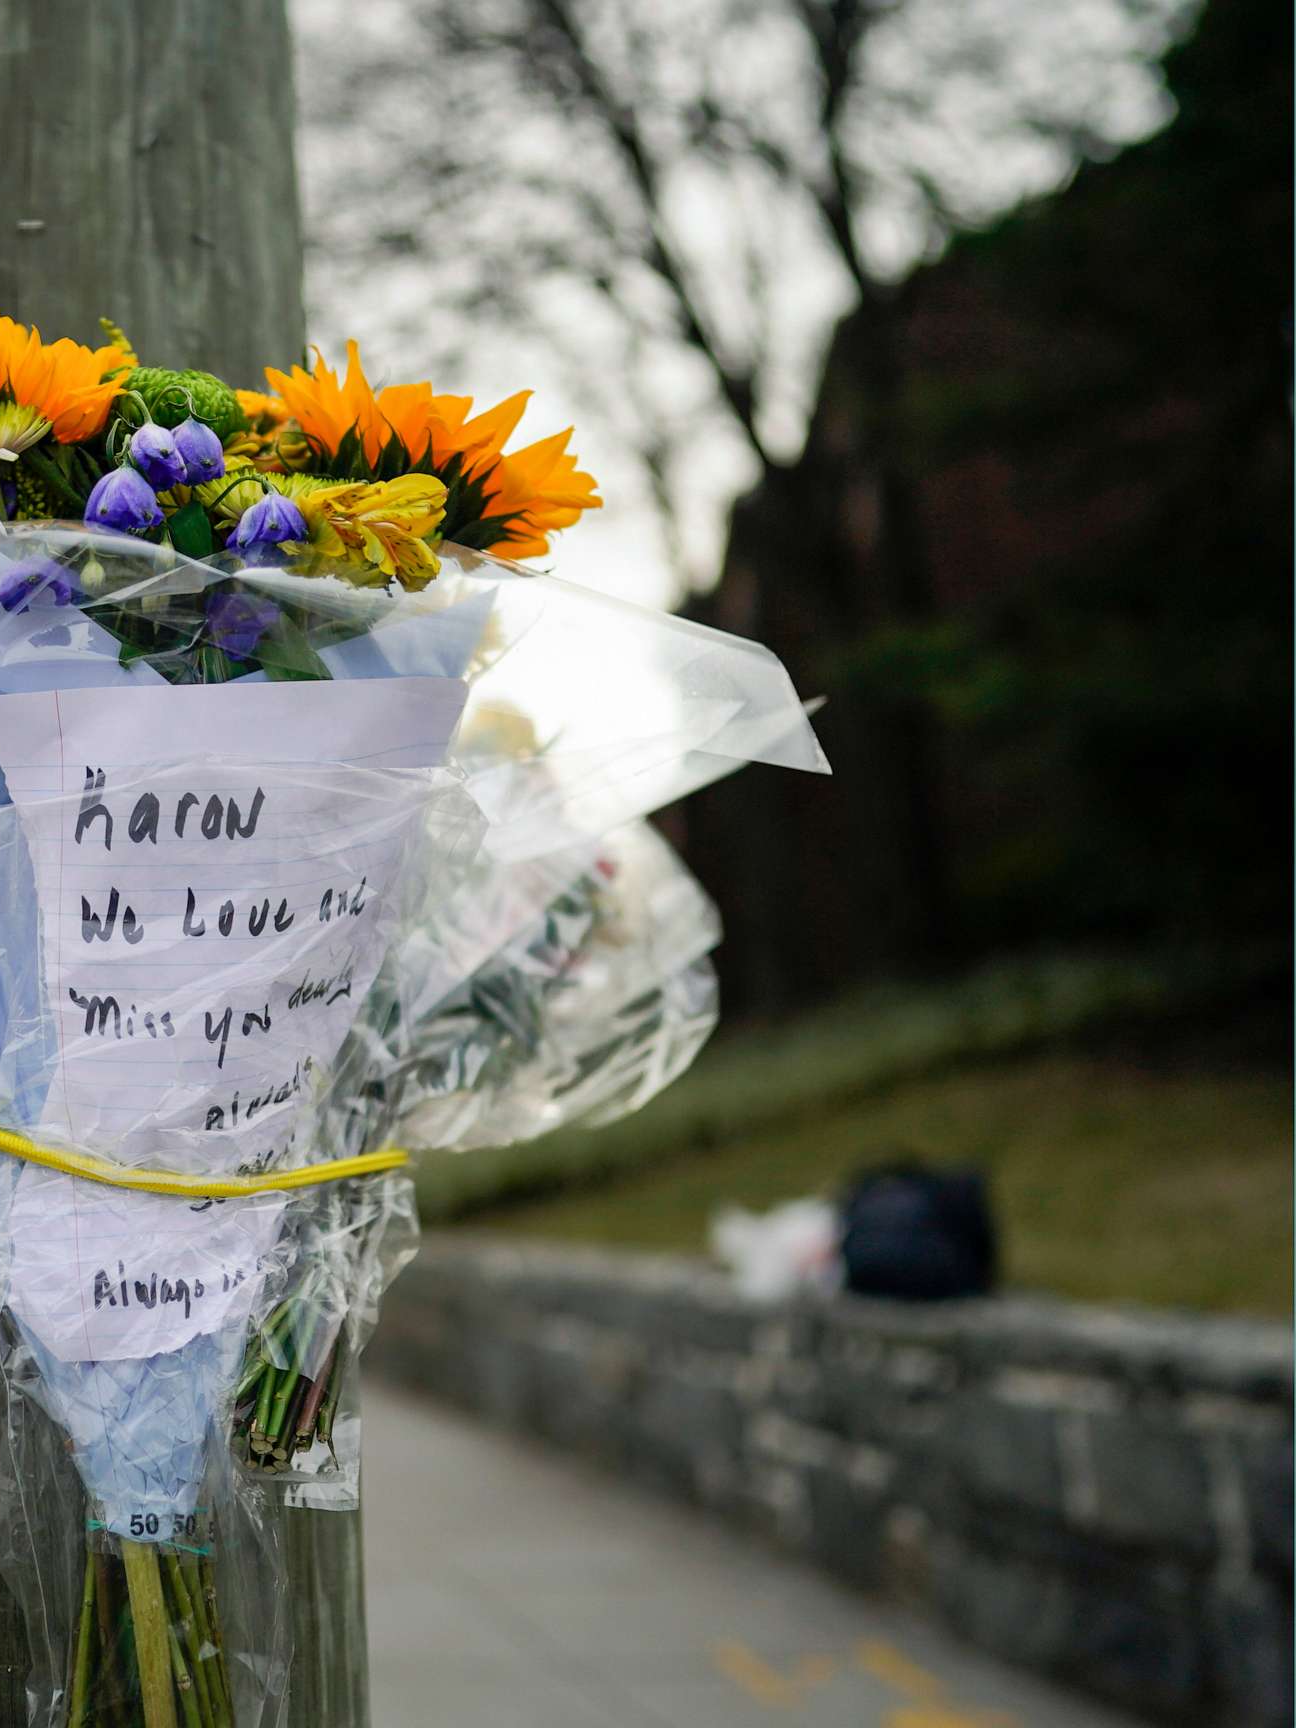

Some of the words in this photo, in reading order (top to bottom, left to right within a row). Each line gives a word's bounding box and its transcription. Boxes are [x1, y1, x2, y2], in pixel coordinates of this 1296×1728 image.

[81, 886, 144, 944] We
[182, 887, 294, 937] Love
[319, 876, 366, 922] and
[69, 987, 175, 1039] Miss
[130, 1512, 159, 1536] 50
[172, 1513, 197, 1537] 50
